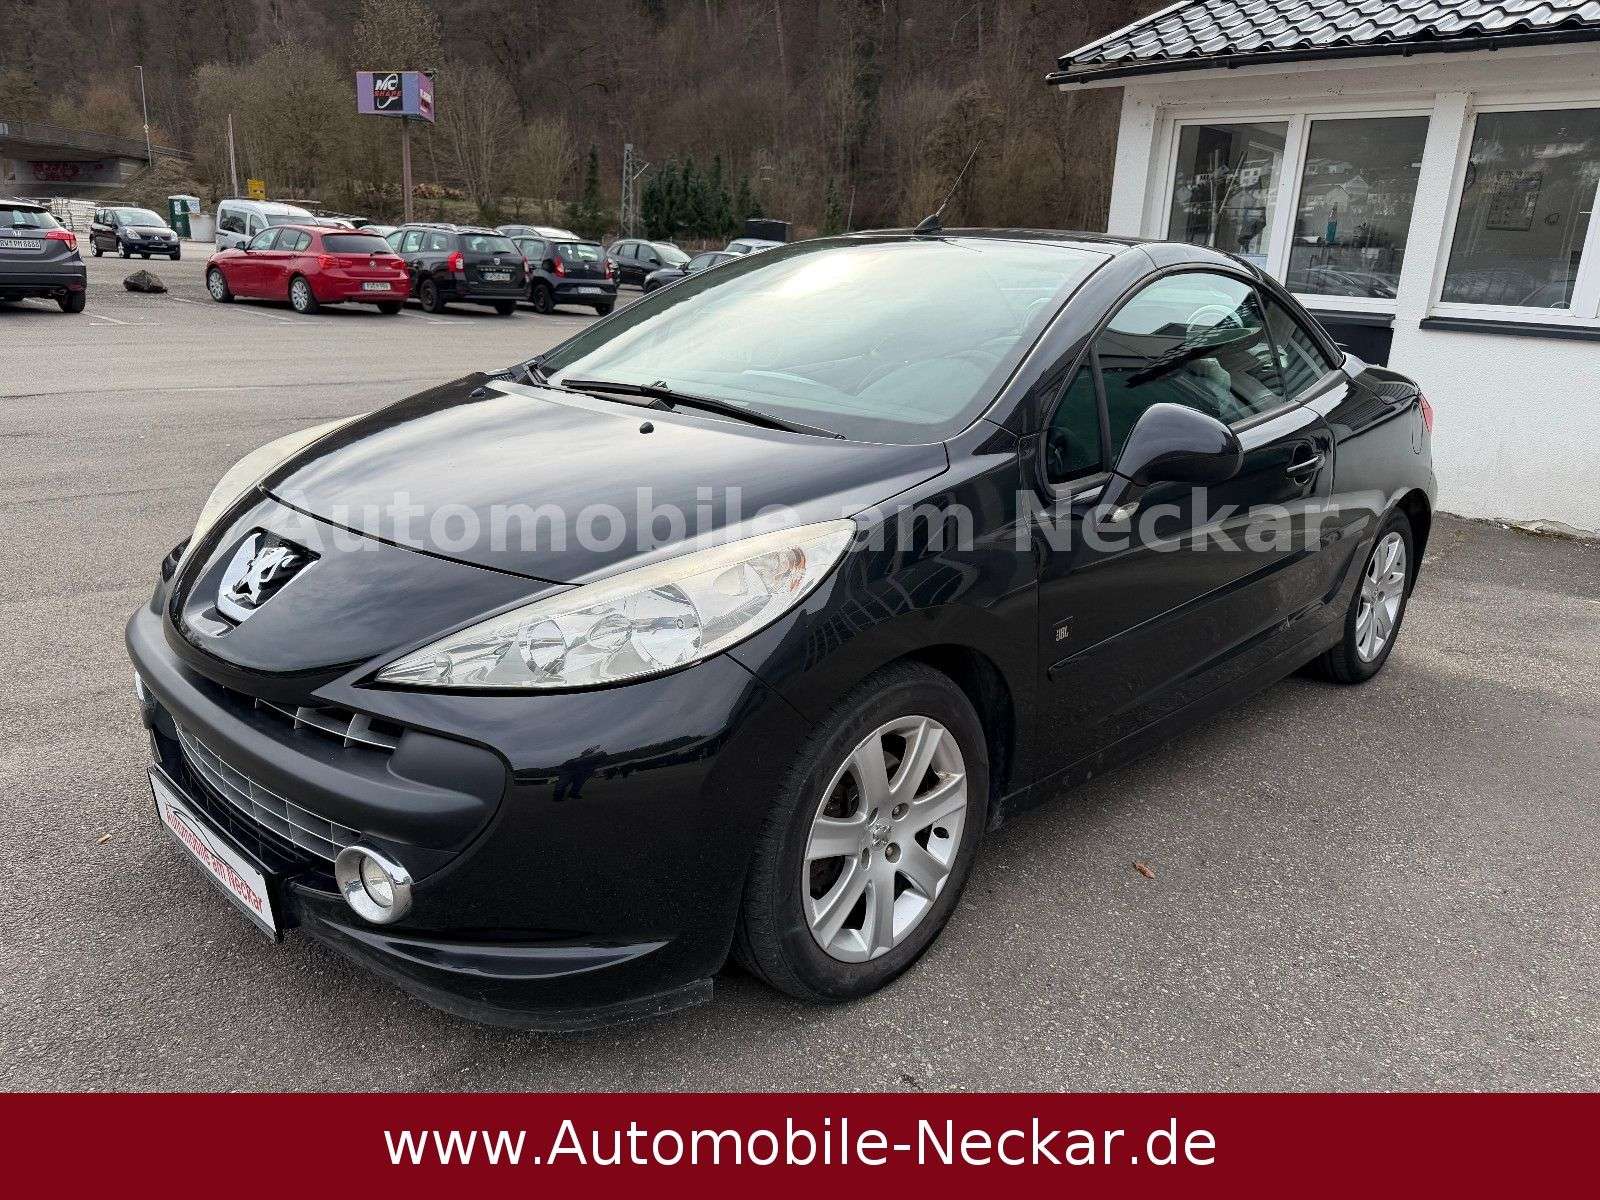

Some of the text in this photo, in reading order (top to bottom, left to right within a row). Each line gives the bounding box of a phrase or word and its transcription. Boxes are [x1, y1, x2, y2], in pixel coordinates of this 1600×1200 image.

[375, 79, 397, 91] MC
[1055, 625, 1070, 642] JBL
[166, 803, 263, 913] Automobile am Neckar
